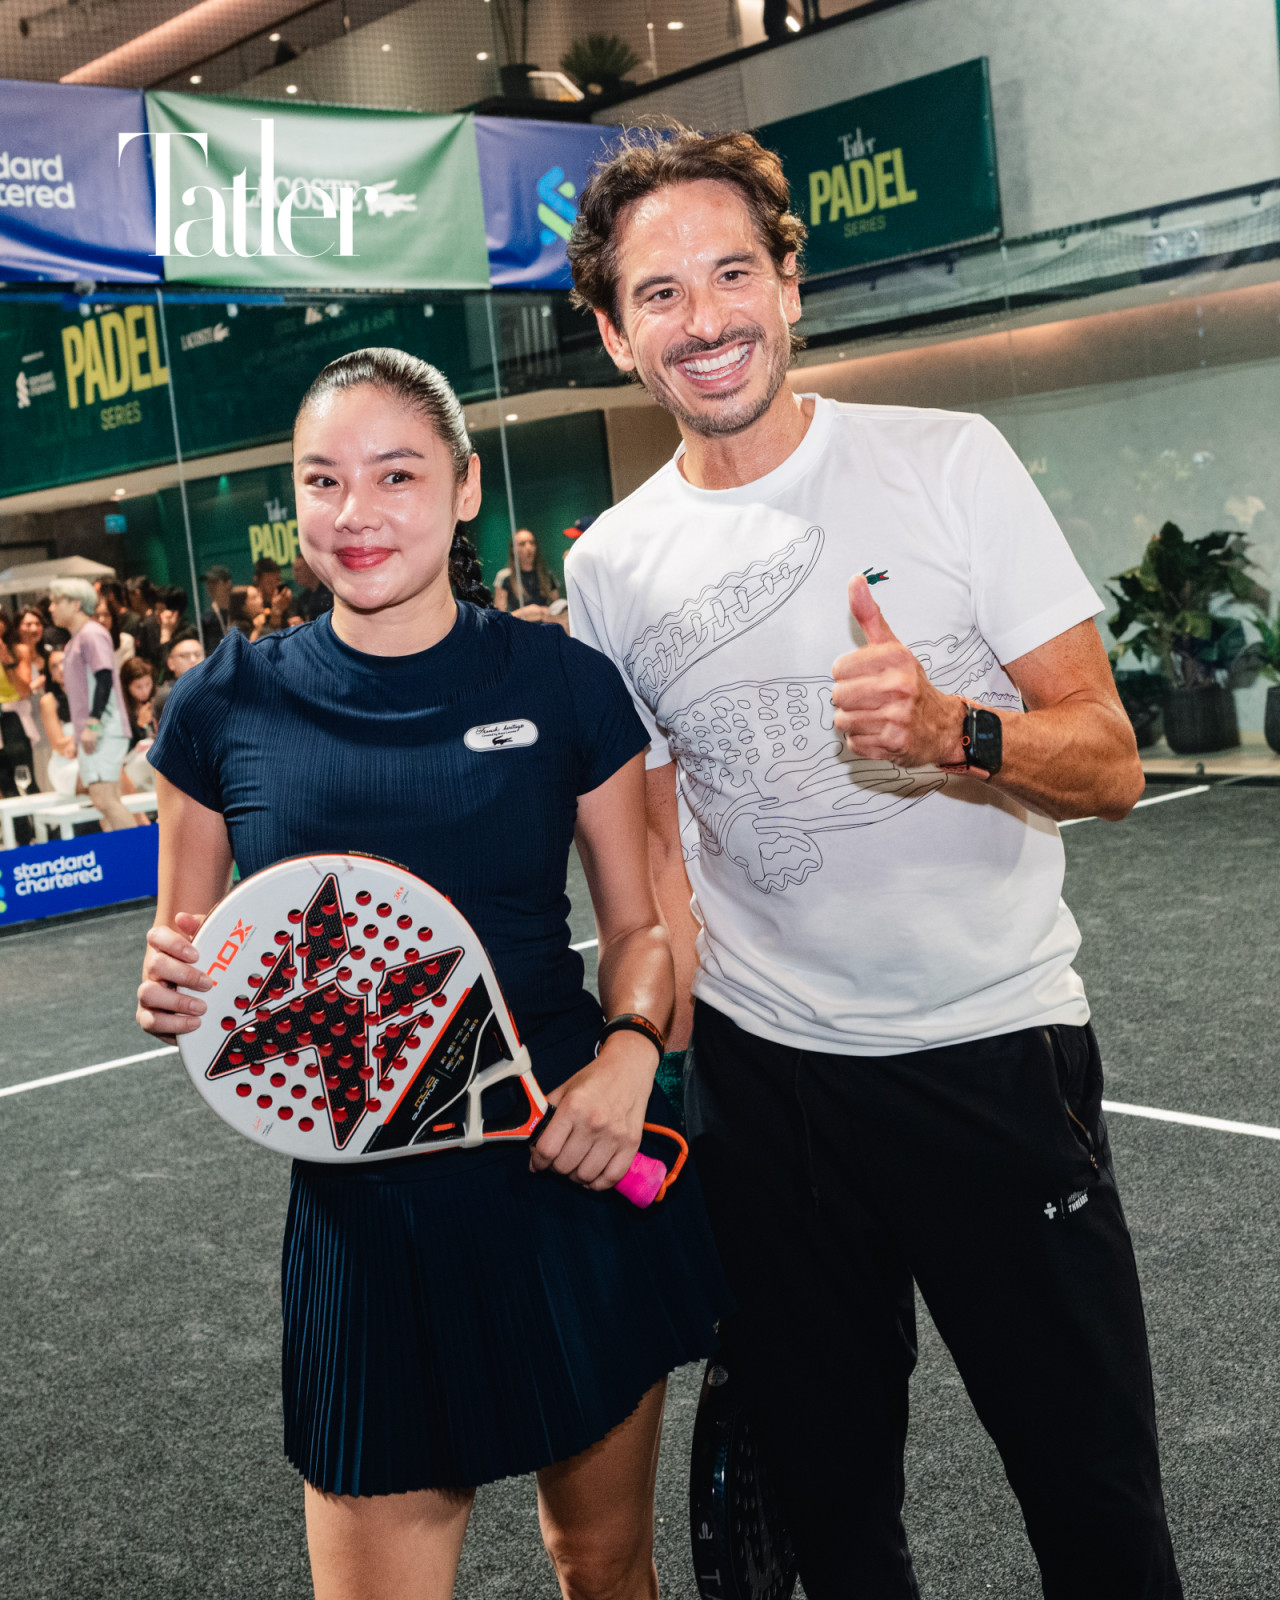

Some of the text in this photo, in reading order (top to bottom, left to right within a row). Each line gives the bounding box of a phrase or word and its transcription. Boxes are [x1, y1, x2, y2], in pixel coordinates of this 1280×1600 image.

[808, 147, 918, 226] PADEL
[844, 215, 886, 238] SERIES
[61, 305, 169, 409] PADEL
[101, 400, 142, 430] SERIES
[248, 518, 299, 566] PADE
[13, 850, 96, 881] standard
[15, 864, 103, 896] chartered
